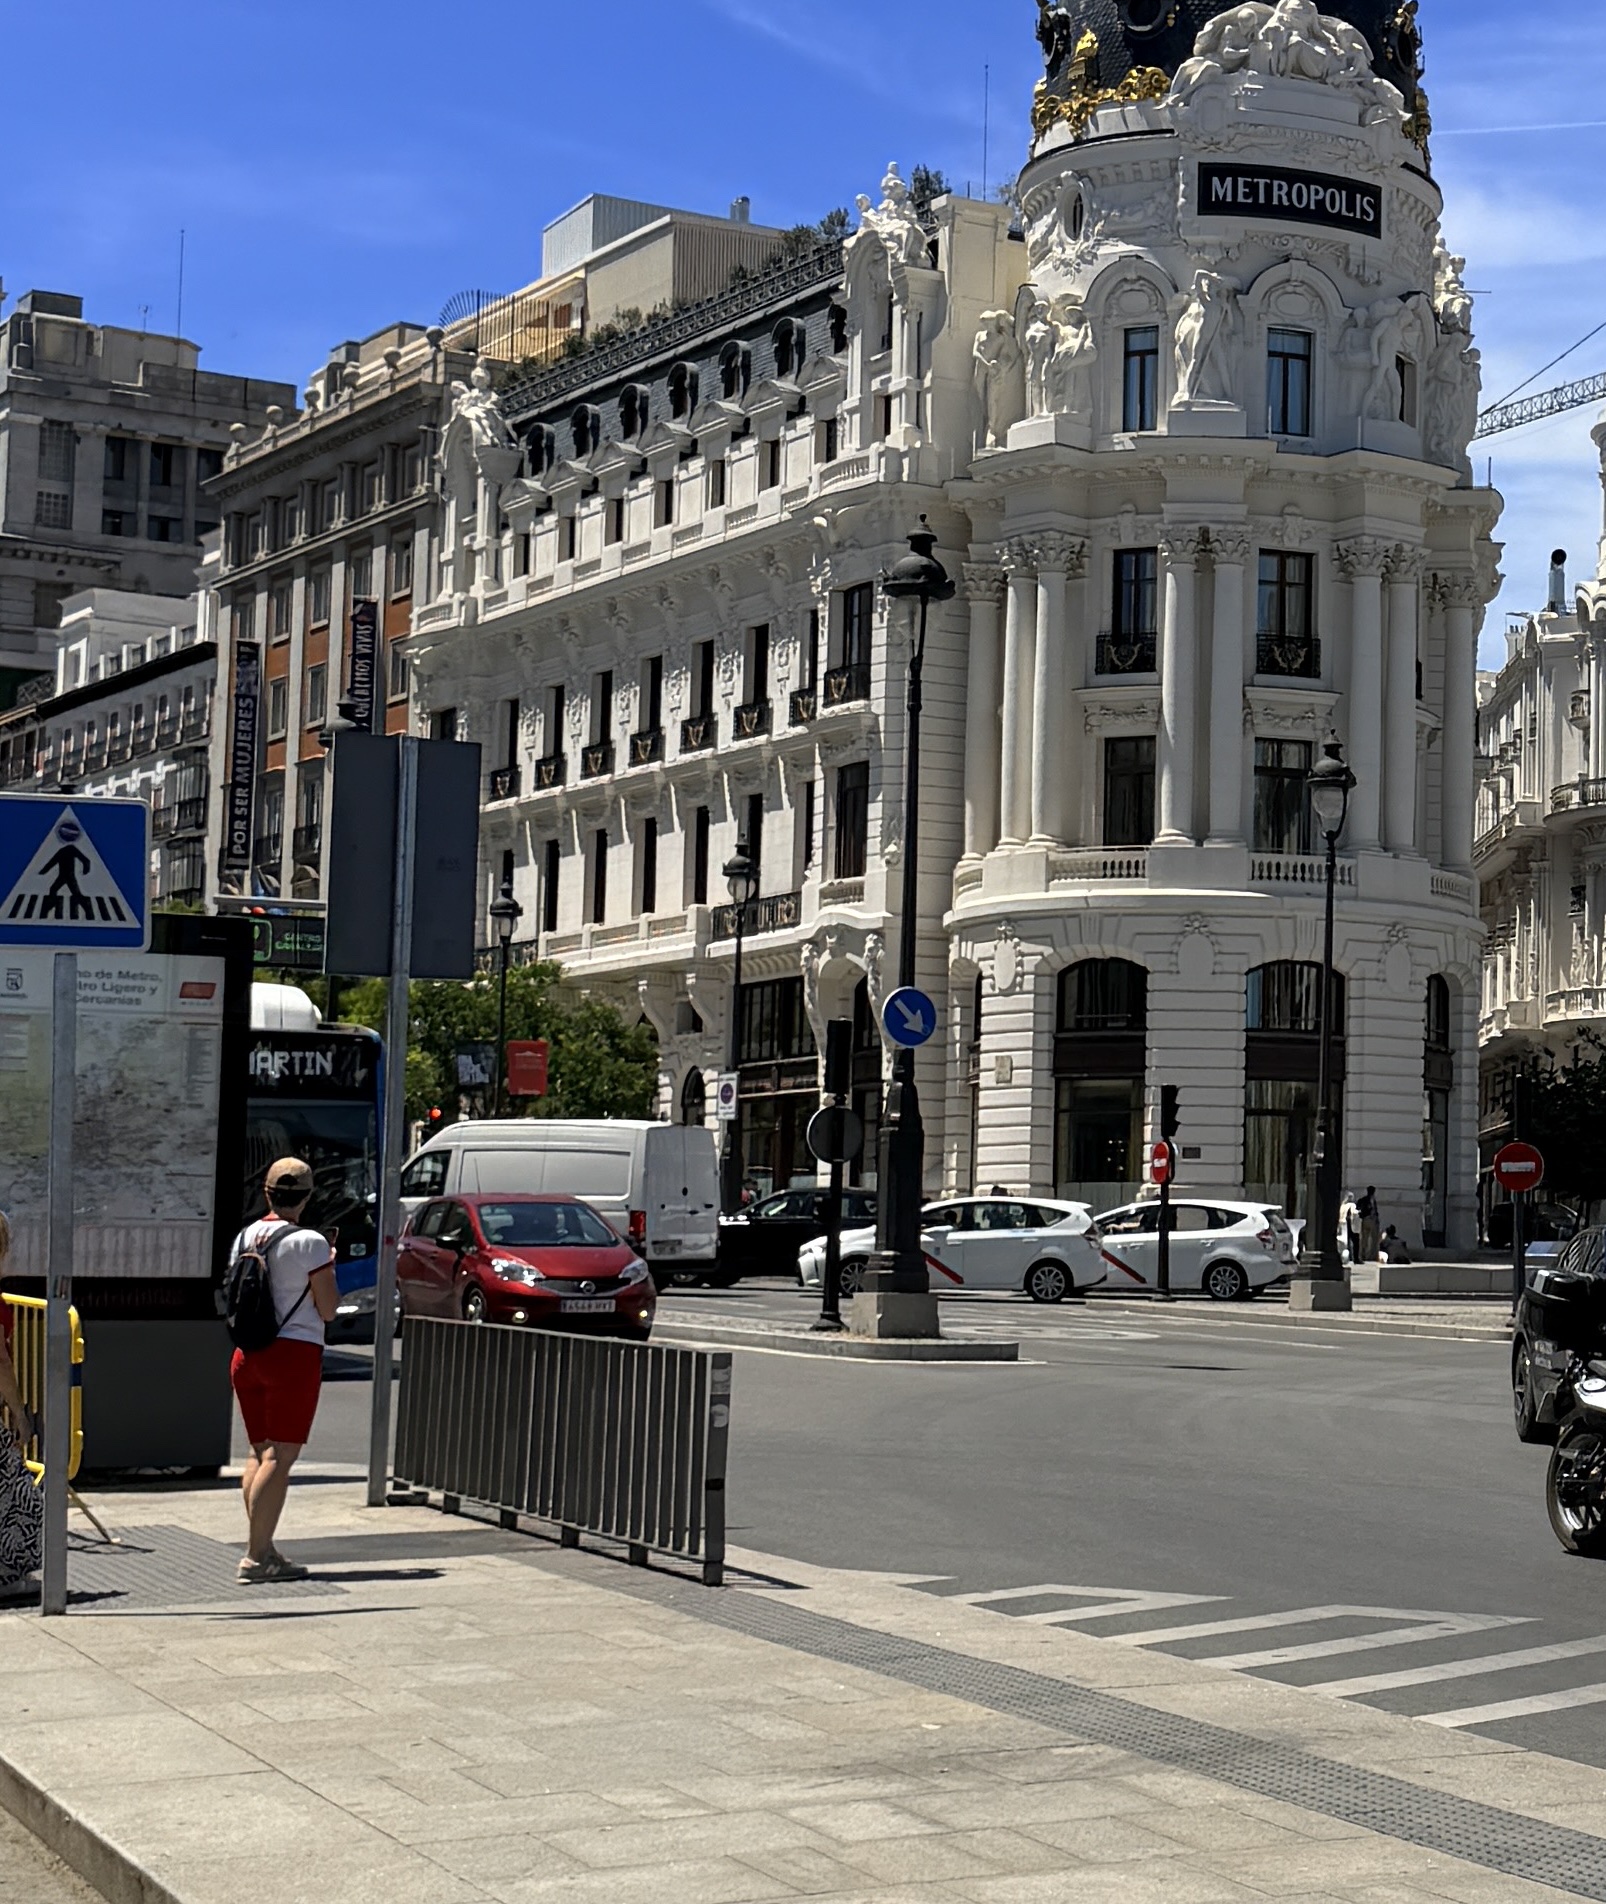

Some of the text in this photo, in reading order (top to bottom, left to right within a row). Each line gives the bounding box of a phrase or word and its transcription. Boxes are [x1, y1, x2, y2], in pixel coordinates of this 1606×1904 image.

[1211, 176, 1376, 222] METROPOLIS
[232, 697, 254, 855] POR SER MUJERES
[95, 969, 113, 979] de
[102, 981, 146, 994] Ligero
[149, 985, 158, 995] y
